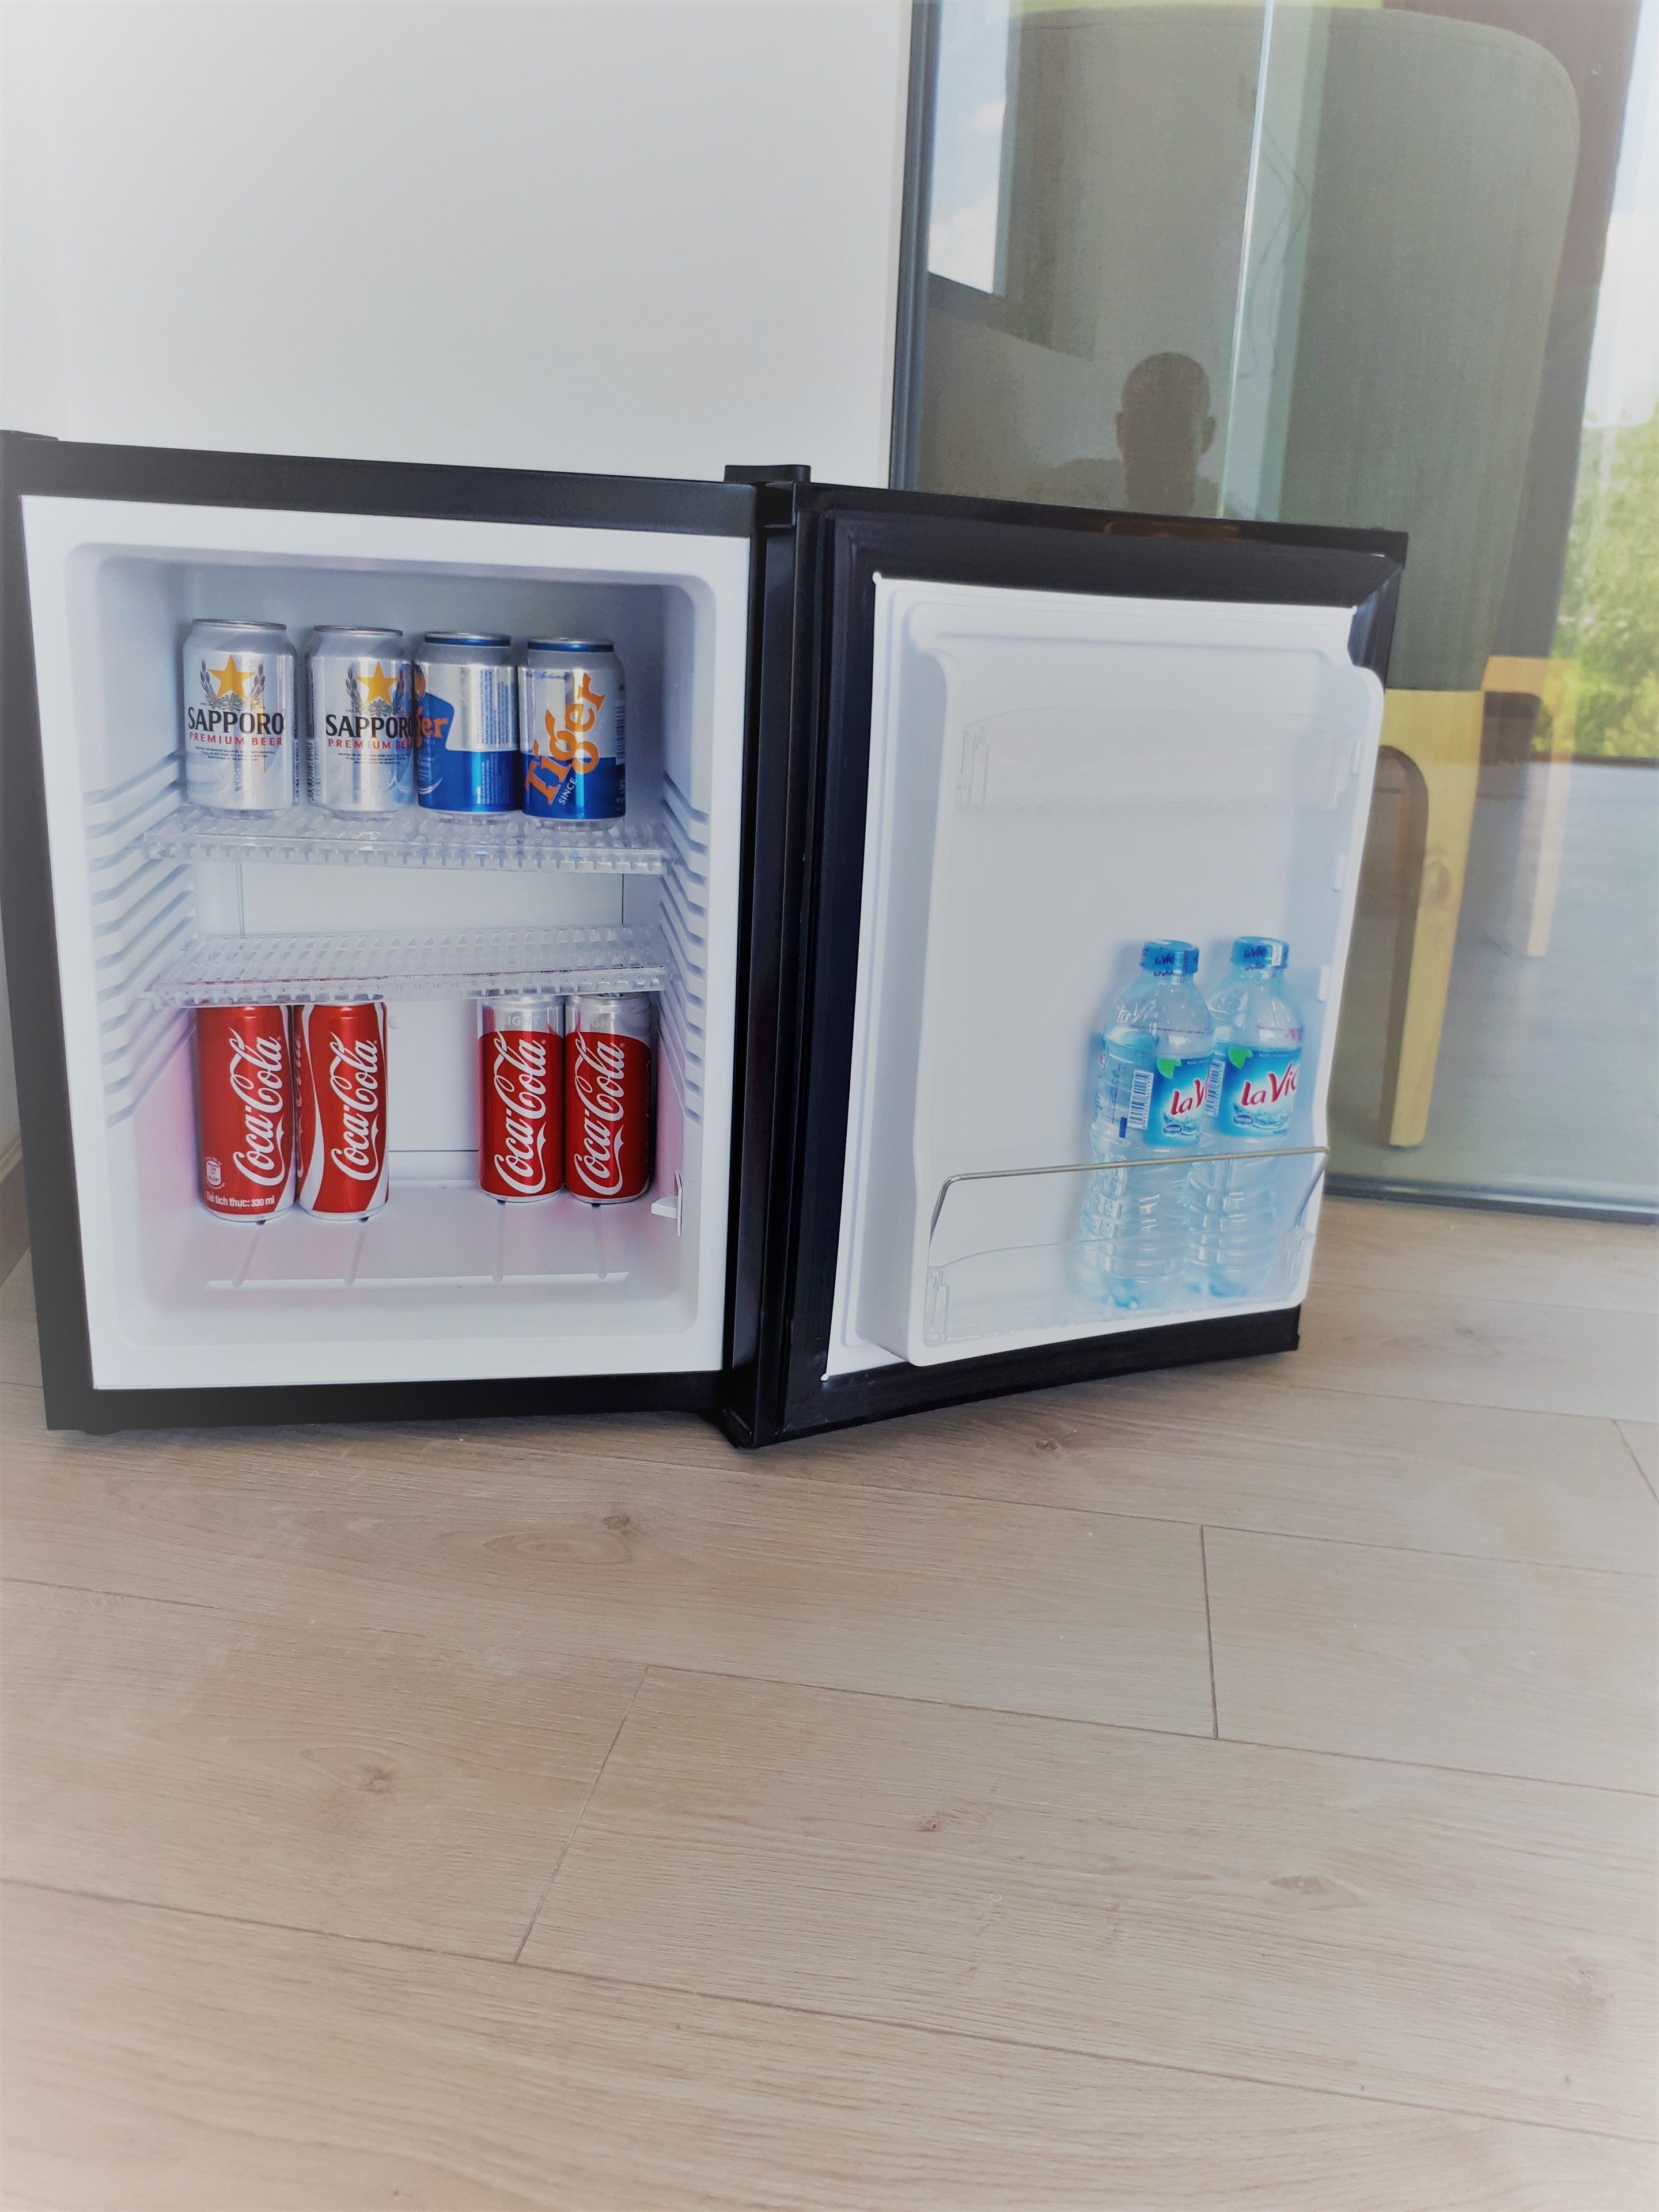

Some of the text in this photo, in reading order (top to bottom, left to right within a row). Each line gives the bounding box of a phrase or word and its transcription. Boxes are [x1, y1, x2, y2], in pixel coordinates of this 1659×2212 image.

[188, 706, 285, 735] SAPPORO
[190, 732, 282, 746] PREMIUM BEER
[558, 777, 577, 805] SINCE
[251, 1198, 264, 1207] 330
[265, 1195, 275, 1205] ml
